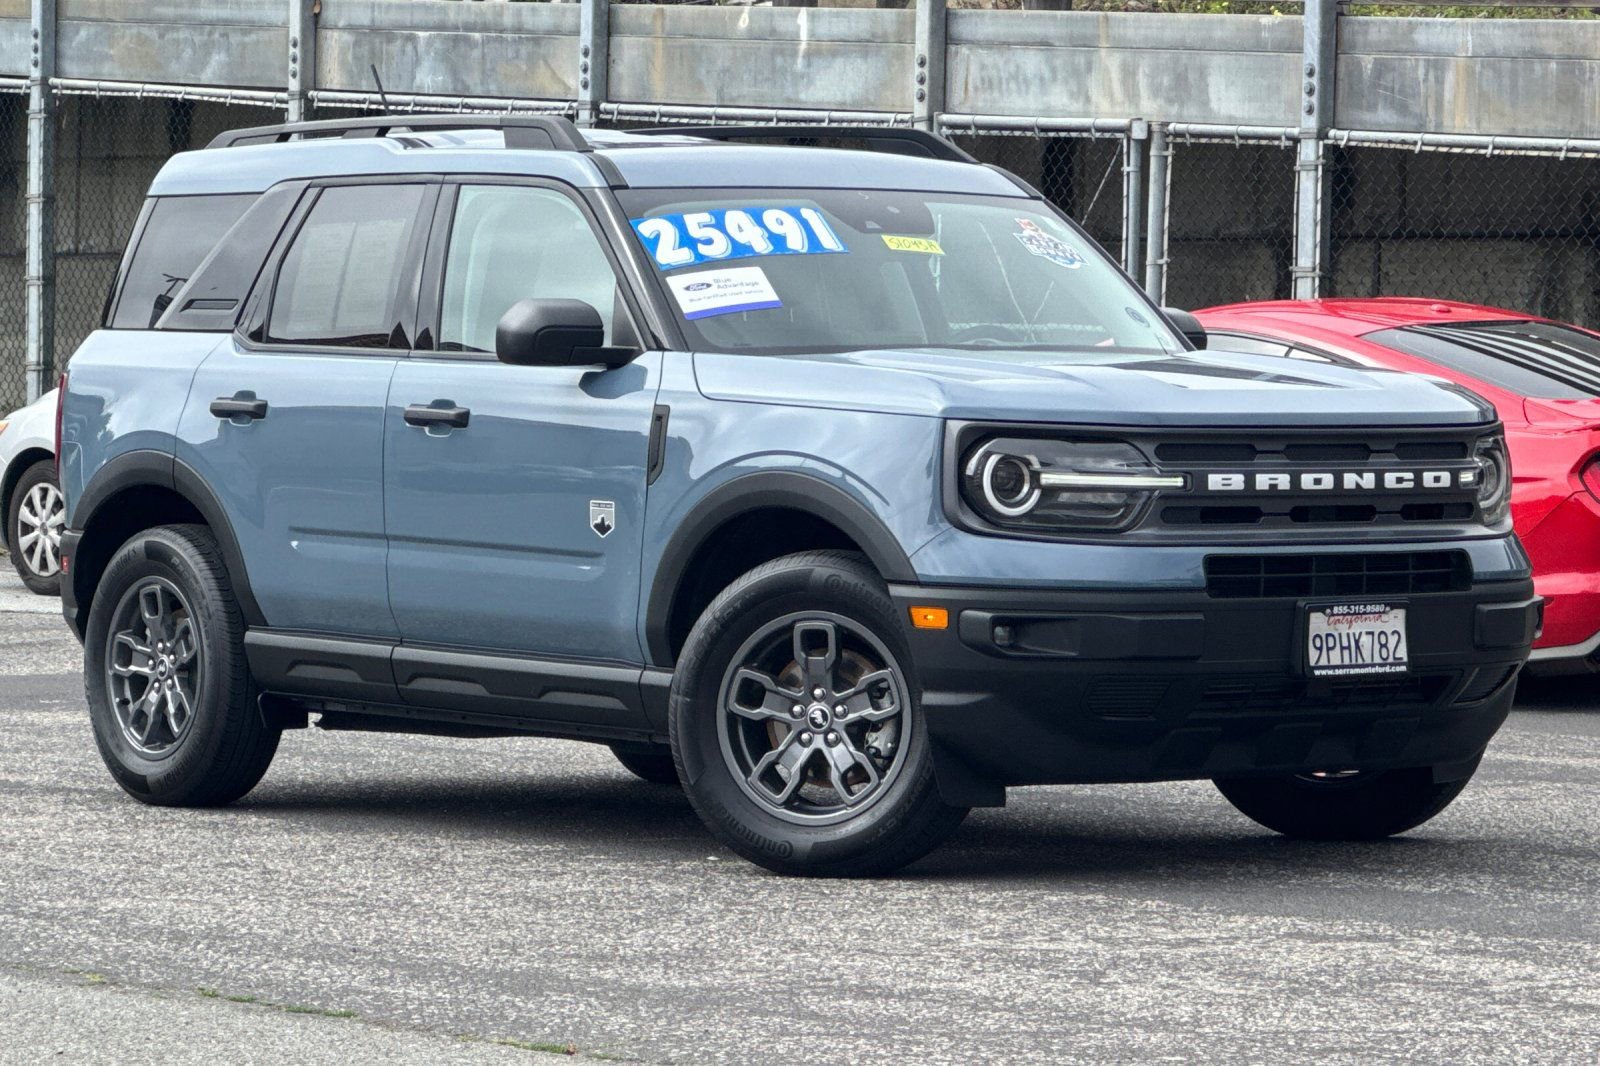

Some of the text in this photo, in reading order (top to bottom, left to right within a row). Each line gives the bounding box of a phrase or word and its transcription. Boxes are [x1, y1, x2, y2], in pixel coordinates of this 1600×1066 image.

[637, 208, 844, 265] 25491
[1207, 471, 1451, 491] BRONCO
[1333, 604, 1385, 614] 855-315-9580
[1327, 614, 1390, 629] California
[1312, 629, 1404, 665] 9PHK782
[1313, 665, 1407, 676] www.serramonteford.com
